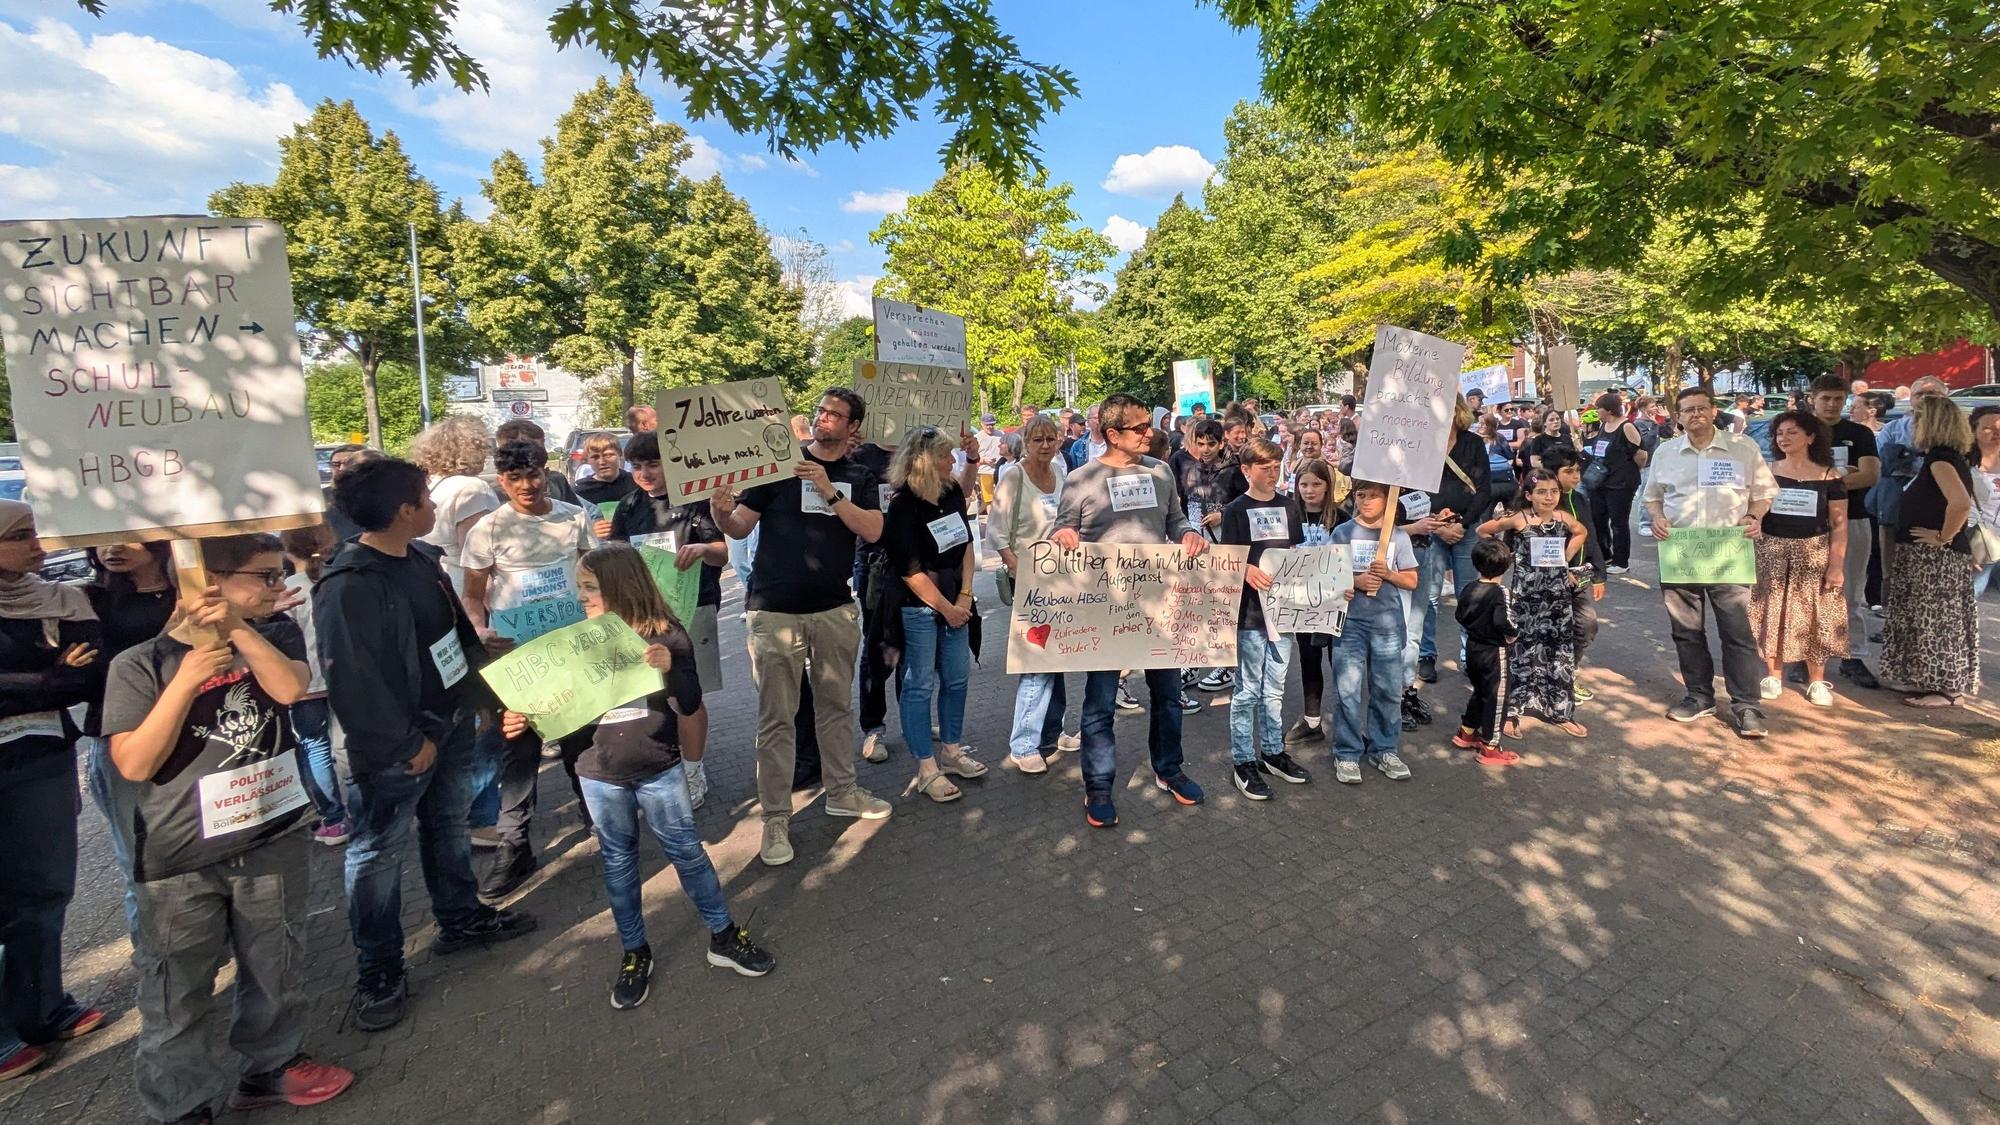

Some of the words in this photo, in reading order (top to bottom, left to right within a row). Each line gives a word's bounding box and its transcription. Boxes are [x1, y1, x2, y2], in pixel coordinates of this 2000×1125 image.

[19, 225, 263, 269] ZUKUNFT
[883, 305, 945, 326] Versprechen
[30, 314, 220, 355] MACHEN
[1383, 331, 1439, 361] Moderne
[45, 361, 190, 396] SCHUL-
[882, 361, 953, 385] KEINE
[1392, 359, 1444, 395] Bildung
[87, 390, 250, 428] NEUBAU
[1376, 388, 1431, 408] braucht
[675, 399, 692, 429] 7
[694, 396, 743, 428] Jahre
[1382, 414, 1430, 430] moderne
[78, 449, 184, 486] HBGB
[1113, 487, 1152, 499] PLATZ!
[1257, 516, 1281, 525] RAUM
[1028, 541, 1112, 574] Politiker
[1115, 549, 1150, 570] haben
[1210, 553, 1242, 572] nicht
[521, 580, 567, 598] UMSONST
[1097, 571, 1164, 592] Aufgepasst
[1023, 588, 1074, 608] Neubau
[1077, 592, 1108, 604] HBGB
[1266, 581, 1322, 609] BAU
[1049, 609, 1074, 624] Mio
[1109, 602, 1135, 616] Finde
[1126, 611, 1141, 620] den
[229, 767, 275, 789] POLITIK
[214, 775, 294, 809] VERLÄSSLICH?
